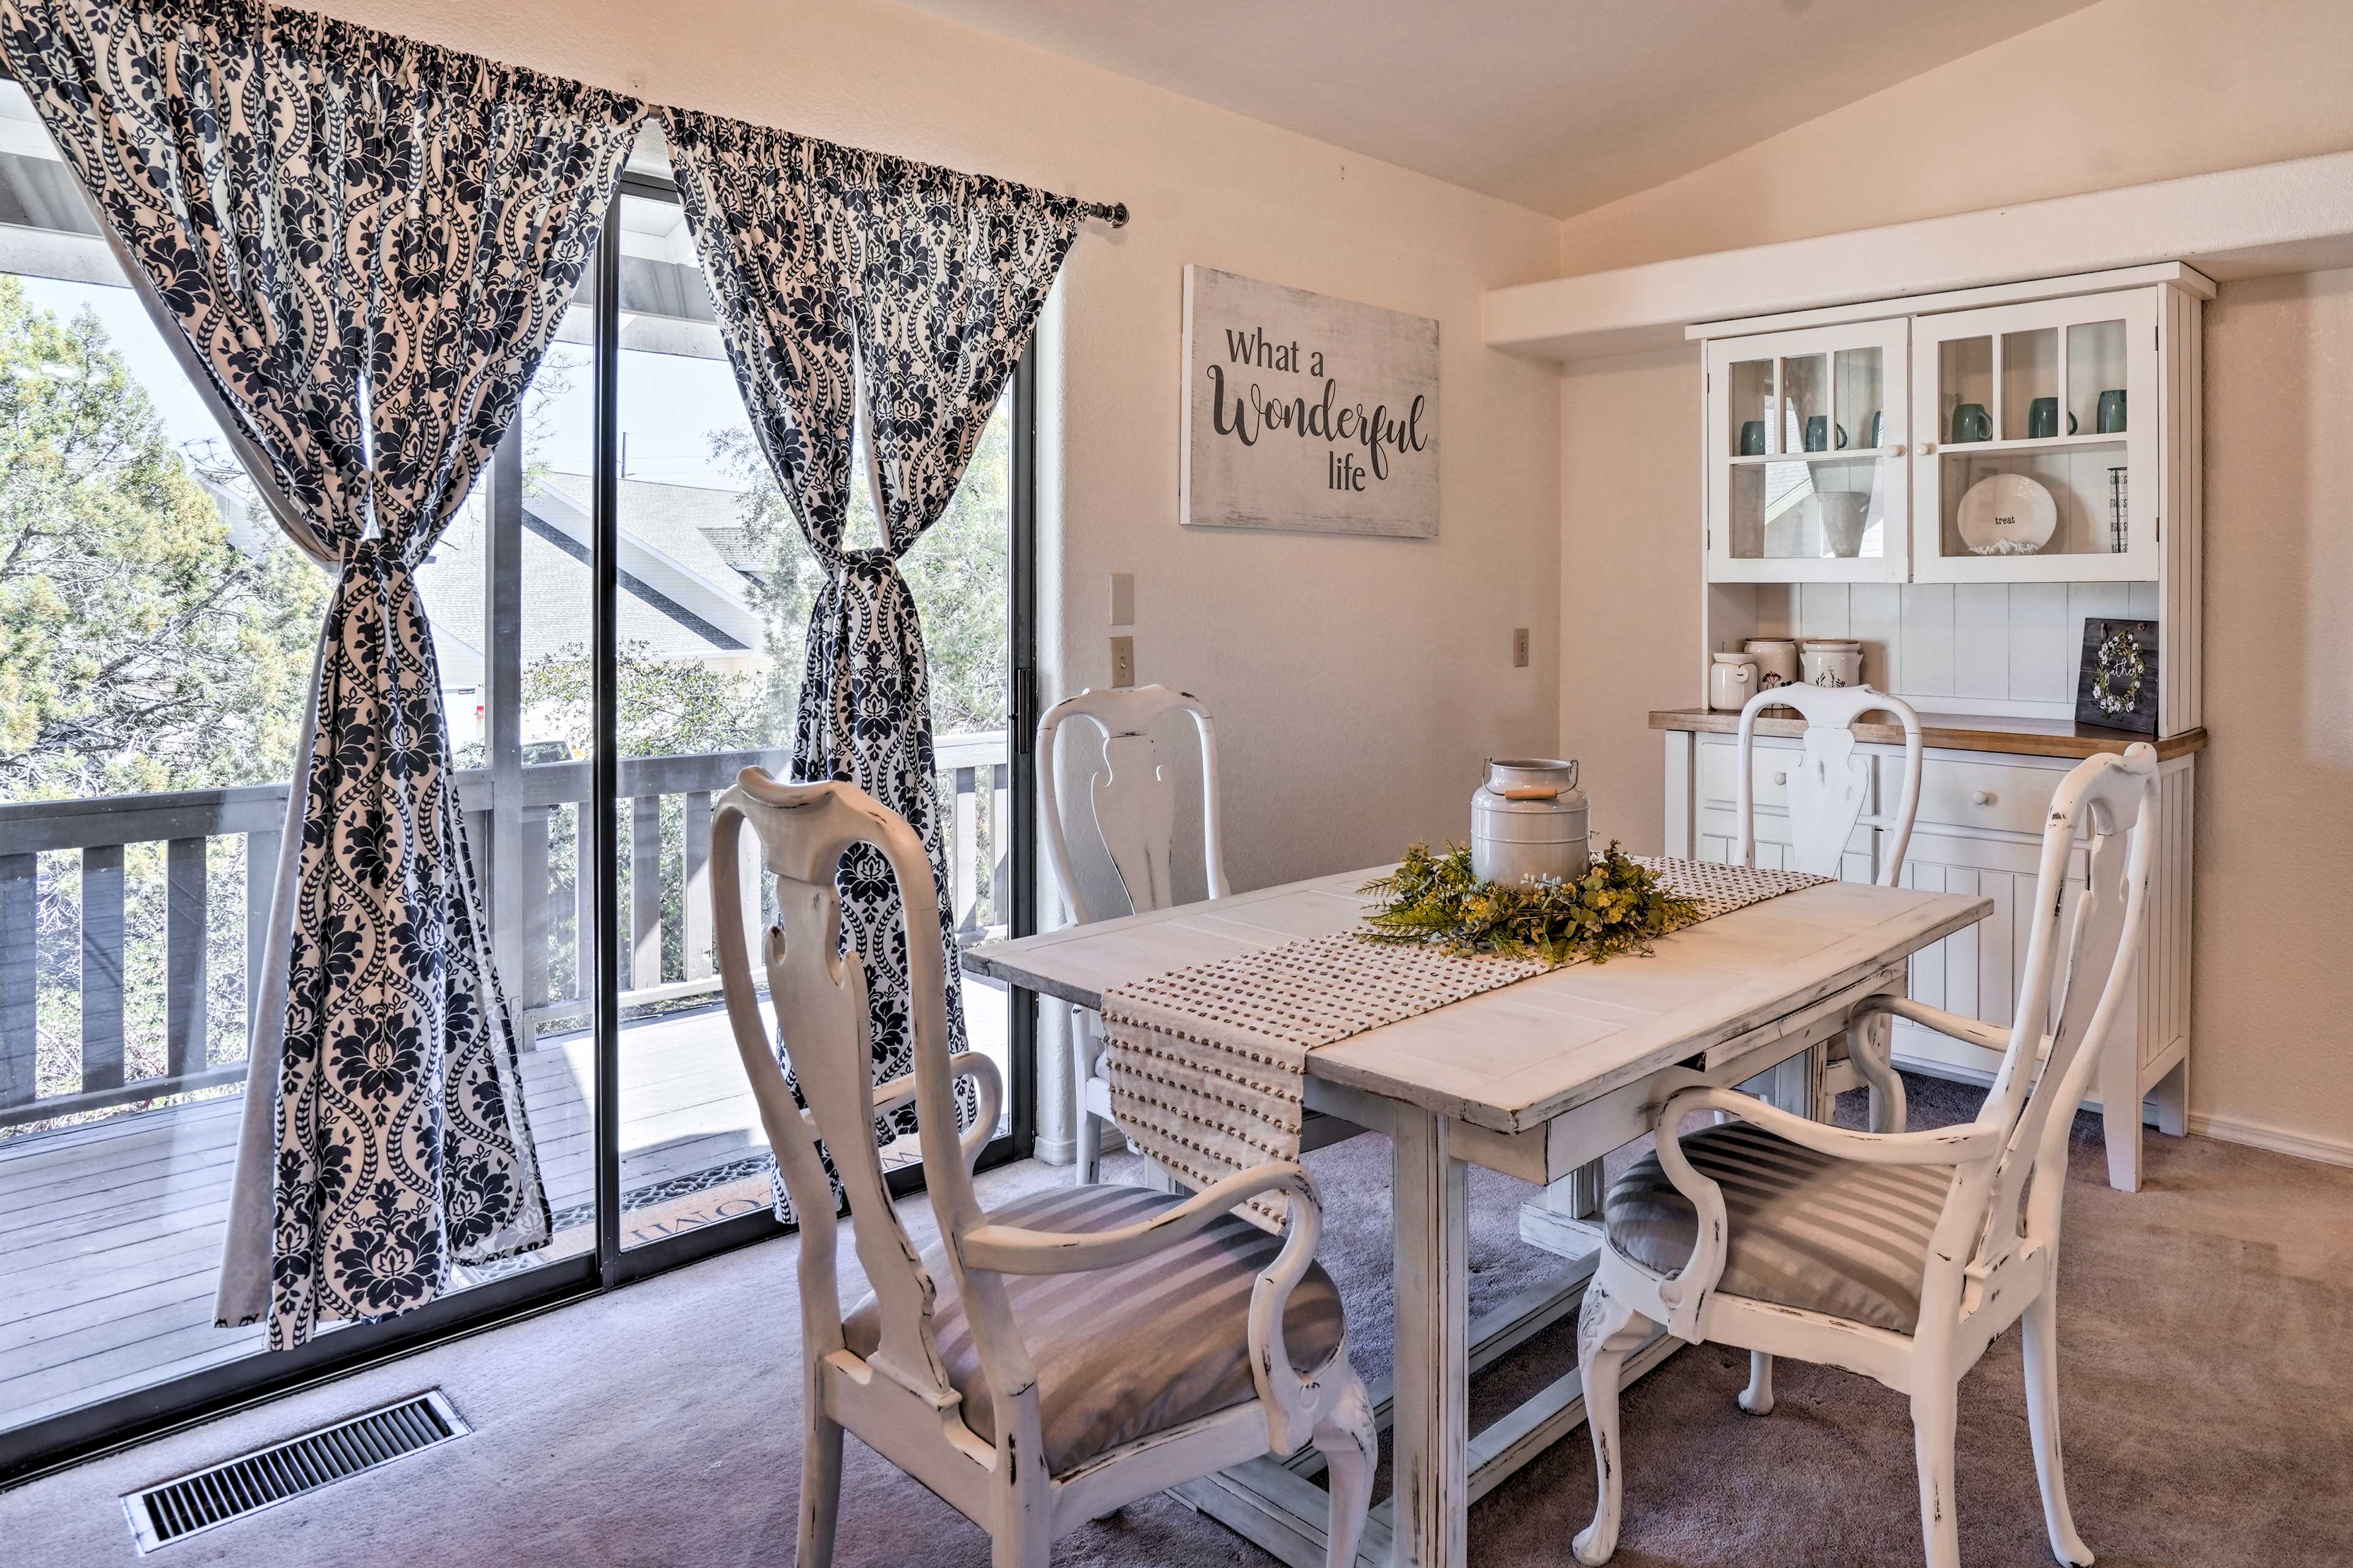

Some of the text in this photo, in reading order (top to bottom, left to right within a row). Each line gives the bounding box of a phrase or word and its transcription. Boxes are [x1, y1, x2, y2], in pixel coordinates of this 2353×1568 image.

[1226, 327, 1324, 377] What a
[1207, 365, 1428, 480] Wonderful
[1328, 450, 1366, 491] life
[1995, 515, 2015, 525] treat
[2104, 657, 2137, 686] gather
